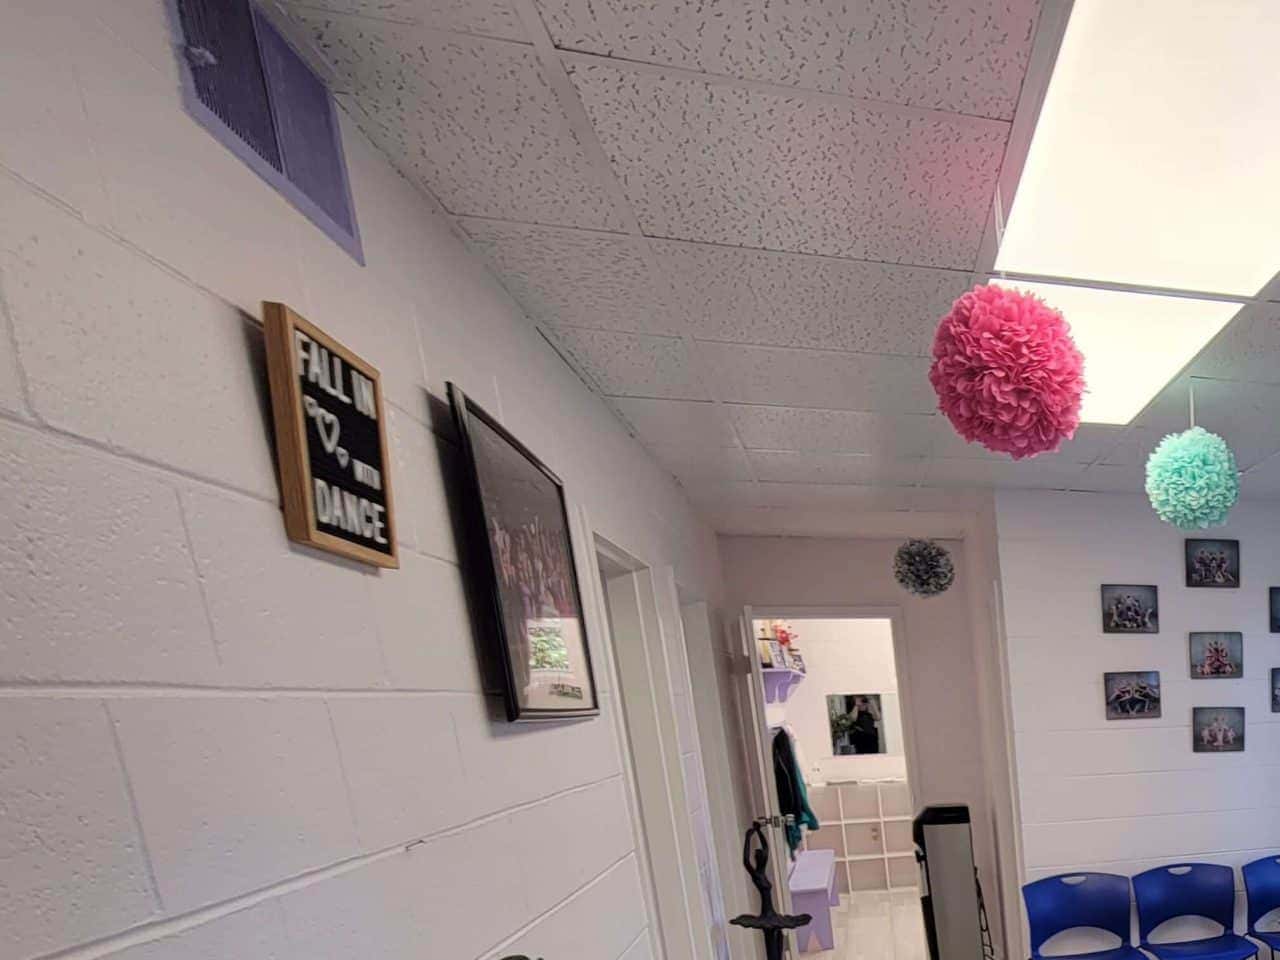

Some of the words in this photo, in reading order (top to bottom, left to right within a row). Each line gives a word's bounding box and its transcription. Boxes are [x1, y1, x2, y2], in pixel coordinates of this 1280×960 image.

[295, 330, 352, 404] FALL
[351, 369, 377, 420] IN
[314, 477, 388, 545] DANCE
